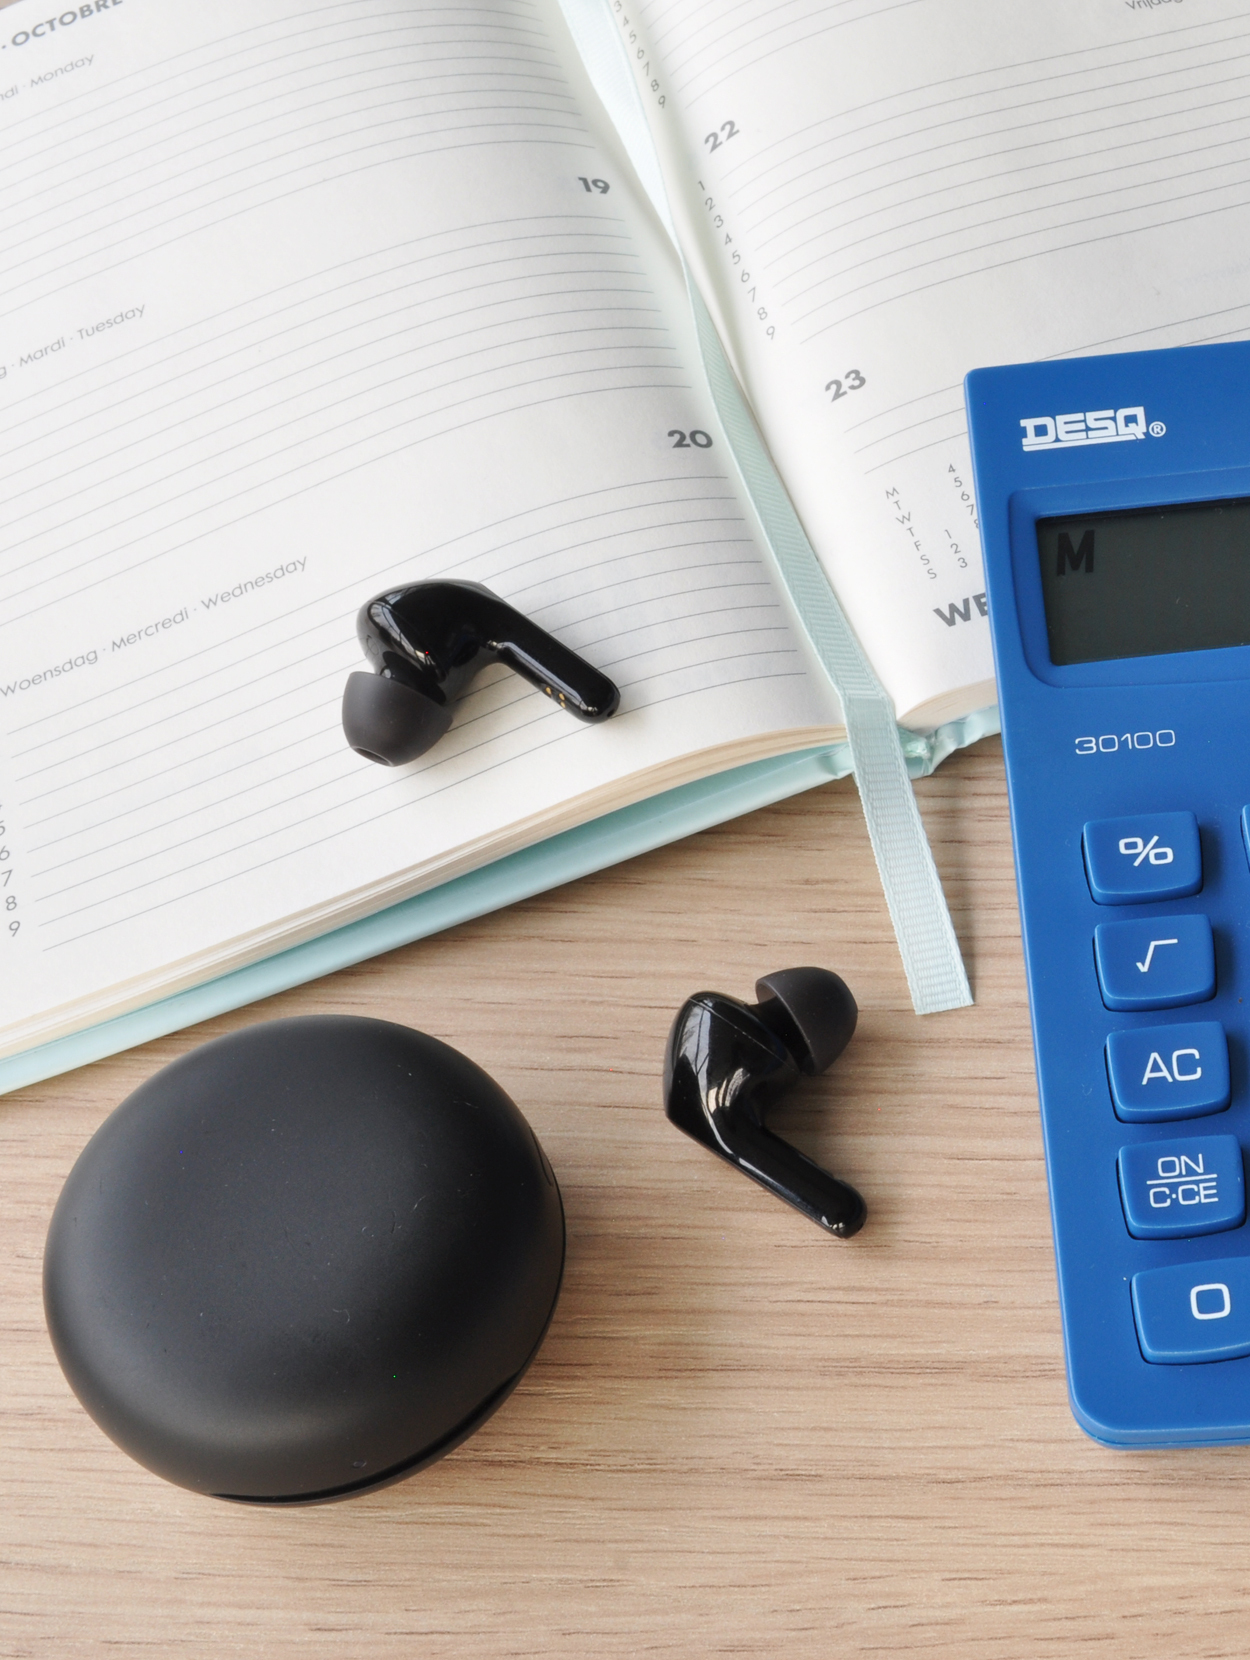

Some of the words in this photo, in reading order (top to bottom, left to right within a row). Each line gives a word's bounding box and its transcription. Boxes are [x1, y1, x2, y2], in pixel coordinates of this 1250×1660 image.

[1124, 0, 1184, 10] Vrij
[628, 29, 638, 45] 5
[636, 46, 646, 60] 6
[30, 53, 95, 88] Monday
[642, 59, 652, 77] 7
[650, 78, 662, 93] 8
[657, 93, 668, 110] 9
[704, 119, 741, 154] 22
[577, 176, 611, 195] 19
[704, 196, 717, 212] 2
[713, 214, 724, 229] 3
[724, 232, 733, 246] 4
[731, 249, 742, 266] 5
[740, 269, 751, 284] 6
[747, 286, 757, 303] 7
[756, 306, 769, 321] 8
[19, 336, 66, 368] Mardi
[76, 304, 146, 340] Tuesday
[765, 325, 776, 341] 9
[824, 368, 867, 403] 23
[667, 429, 714, 449] 20
[885, 486, 900, 502] M
[947, 463, 957, 473] 4
[892, 499, 902, 511] T
[953, 476, 963, 488] 5
[895, 511, 911, 525] W
[960, 490, 971, 502] 6
[906, 526, 915, 538] T
[965, 503, 975, 516] 7
[913, 539, 922, 552] F
[919, 554, 931, 566] S
[949, 542, 962, 555] 2
[1056, 529, 1097, 577] M
[926, 567, 938, 580] S
[957, 556, 968, 569] 3
[0, 648, 99, 698] Woensdag
[111, 606, 190, 653] Mercredi
[200, 555, 308, 611] Wednesday
[1074, 729, 1176, 755] 30100
[0, 868, 14, 888] 7
[5, 895, 18, 912] 8
[8, 920, 21, 938] 9
[1141, 1048, 1202, 1086] AC
[1157, 1153, 1204, 1178] ON
[1189, 1282, 1232, 1320] 0
